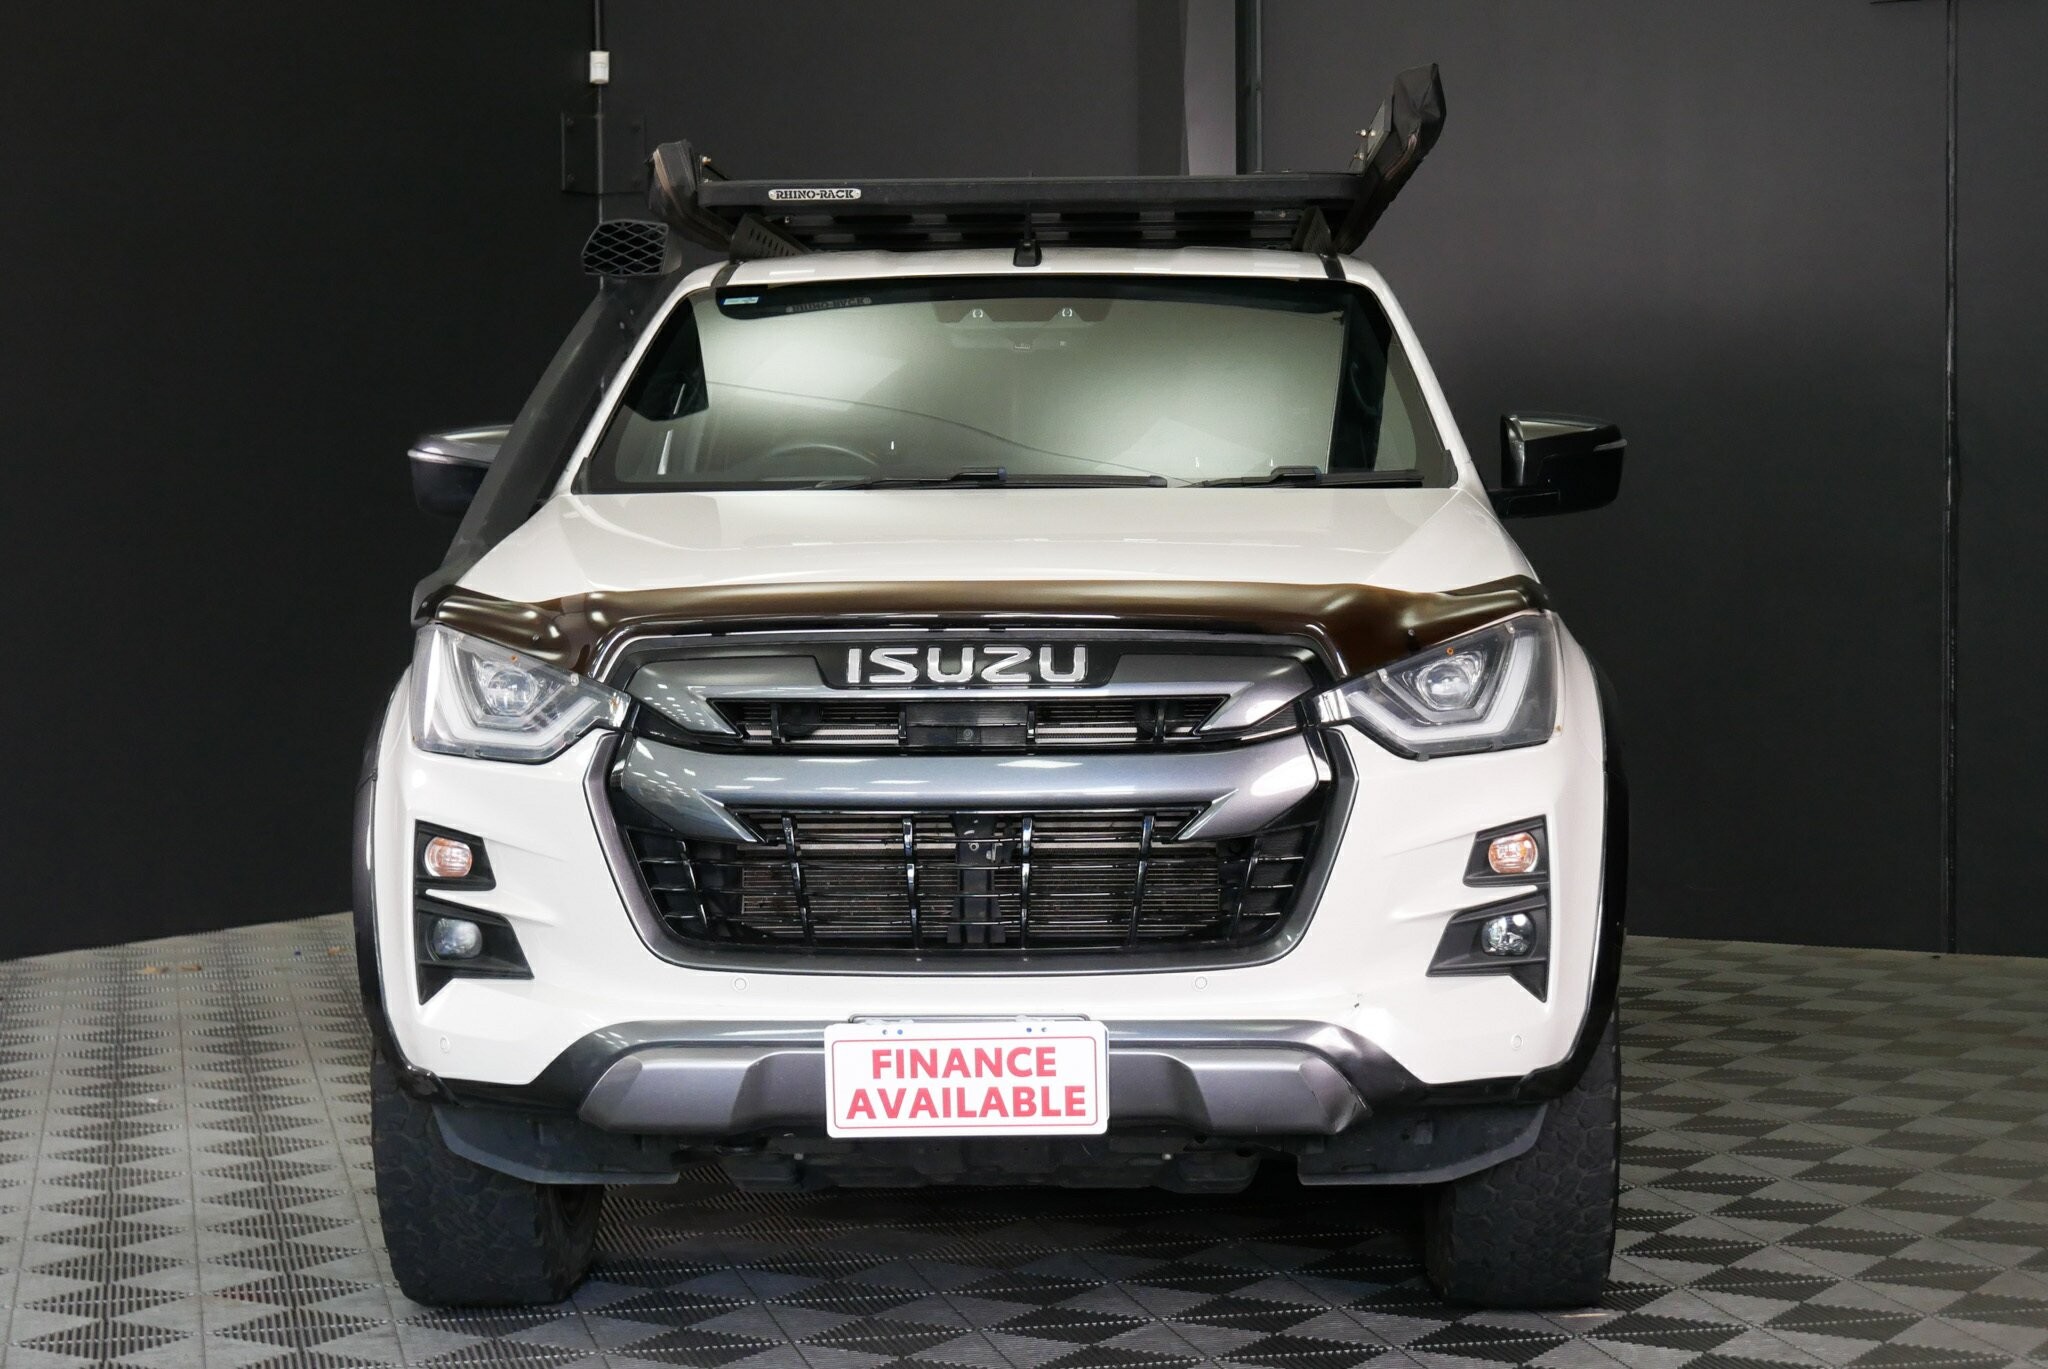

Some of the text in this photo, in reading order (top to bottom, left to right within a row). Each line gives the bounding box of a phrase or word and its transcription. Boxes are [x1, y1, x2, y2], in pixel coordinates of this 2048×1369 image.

[775, 188, 855, 200] RHINO-RACK
[846, 645, 1087, 683] ISUZU
[872, 1046, 1057, 1079] FINANCE
[846, 1085, 1086, 1119] AVAILABLE
